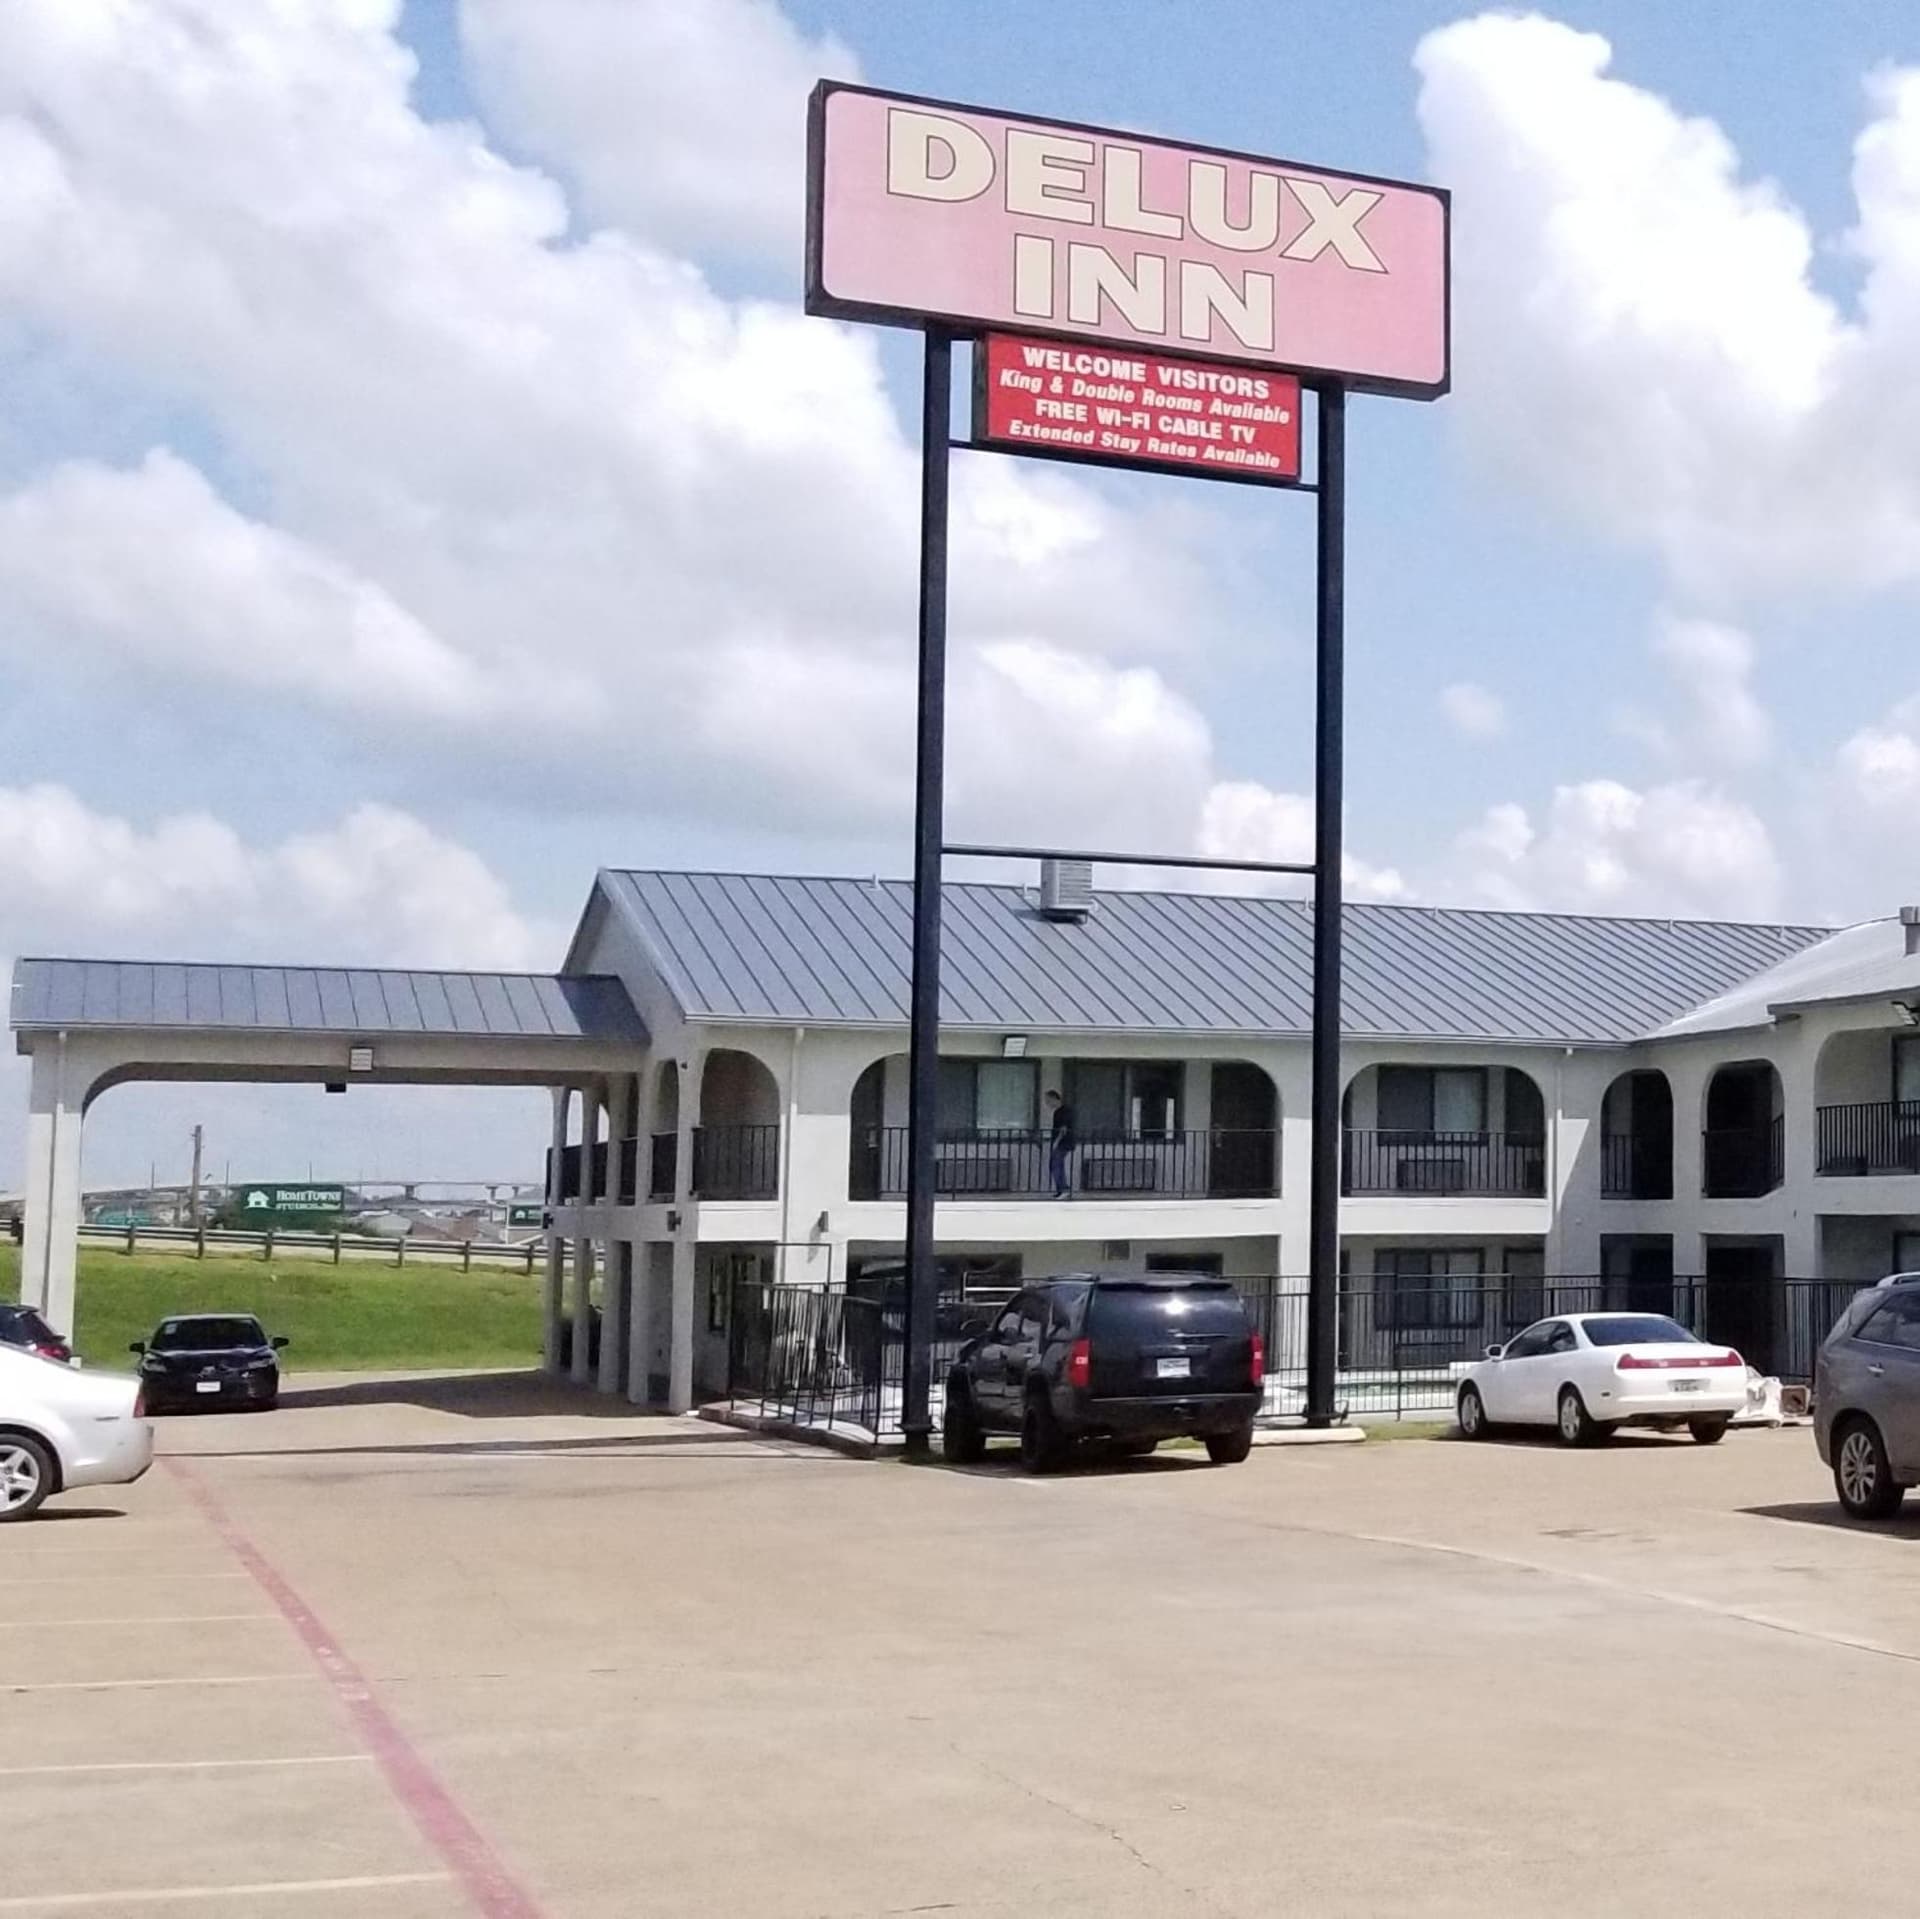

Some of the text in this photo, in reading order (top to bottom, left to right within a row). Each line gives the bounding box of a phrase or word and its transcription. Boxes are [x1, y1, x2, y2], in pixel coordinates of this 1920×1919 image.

[887, 107, 1389, 274] DELUX
[1013, 233, 1275, 352] INN
[1000, 369, 1291, 425] King & Double Rooms Available
[1022, 347, 1270, 399] WELCOME VISITORS
[1009, 420, 1281, 469] Extended Stay Rates Available
[1036, 400, 1256, 444] FREE WI-FI CABLE TV
